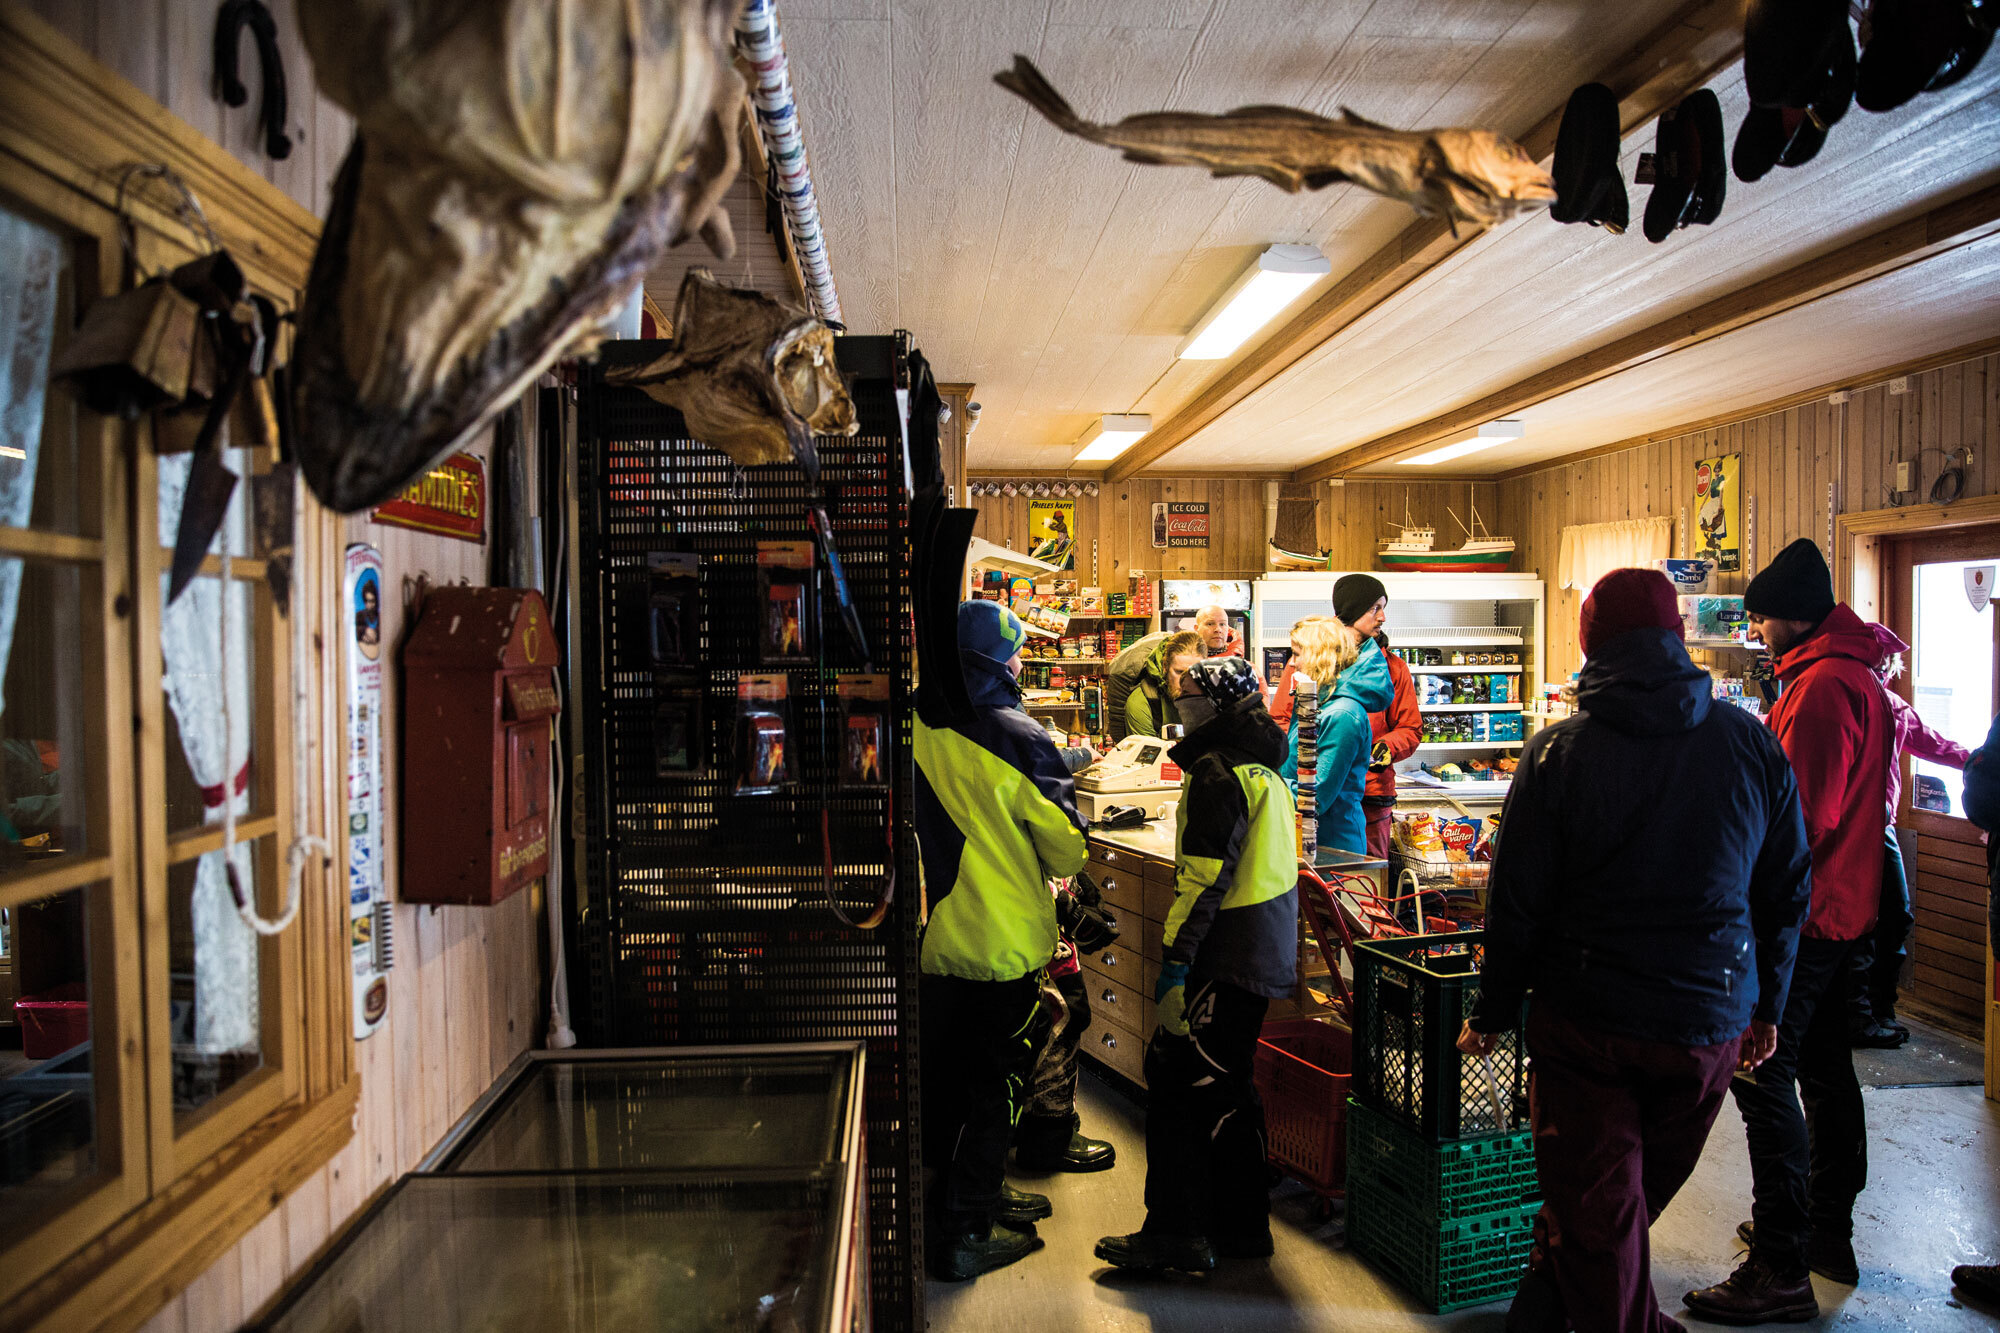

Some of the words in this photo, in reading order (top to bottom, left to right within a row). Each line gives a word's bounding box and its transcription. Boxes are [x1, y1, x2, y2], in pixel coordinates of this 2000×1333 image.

[1031, 501, 1054, 509] FRIELES
[1055, 501, 1073, 510] KAFFE
[1172, 504, 1184, 512] ICE
[1185, 504, 1205, 512] COLD
[1171, 538, 1189, 546] SOLD
[1190, 538, 1207, 546] HERE
[1720, 612, 1741, 620] Lambi
[1443, 828, 1461, 838] Gull
[1449, 833, 1472, 843] vafler
